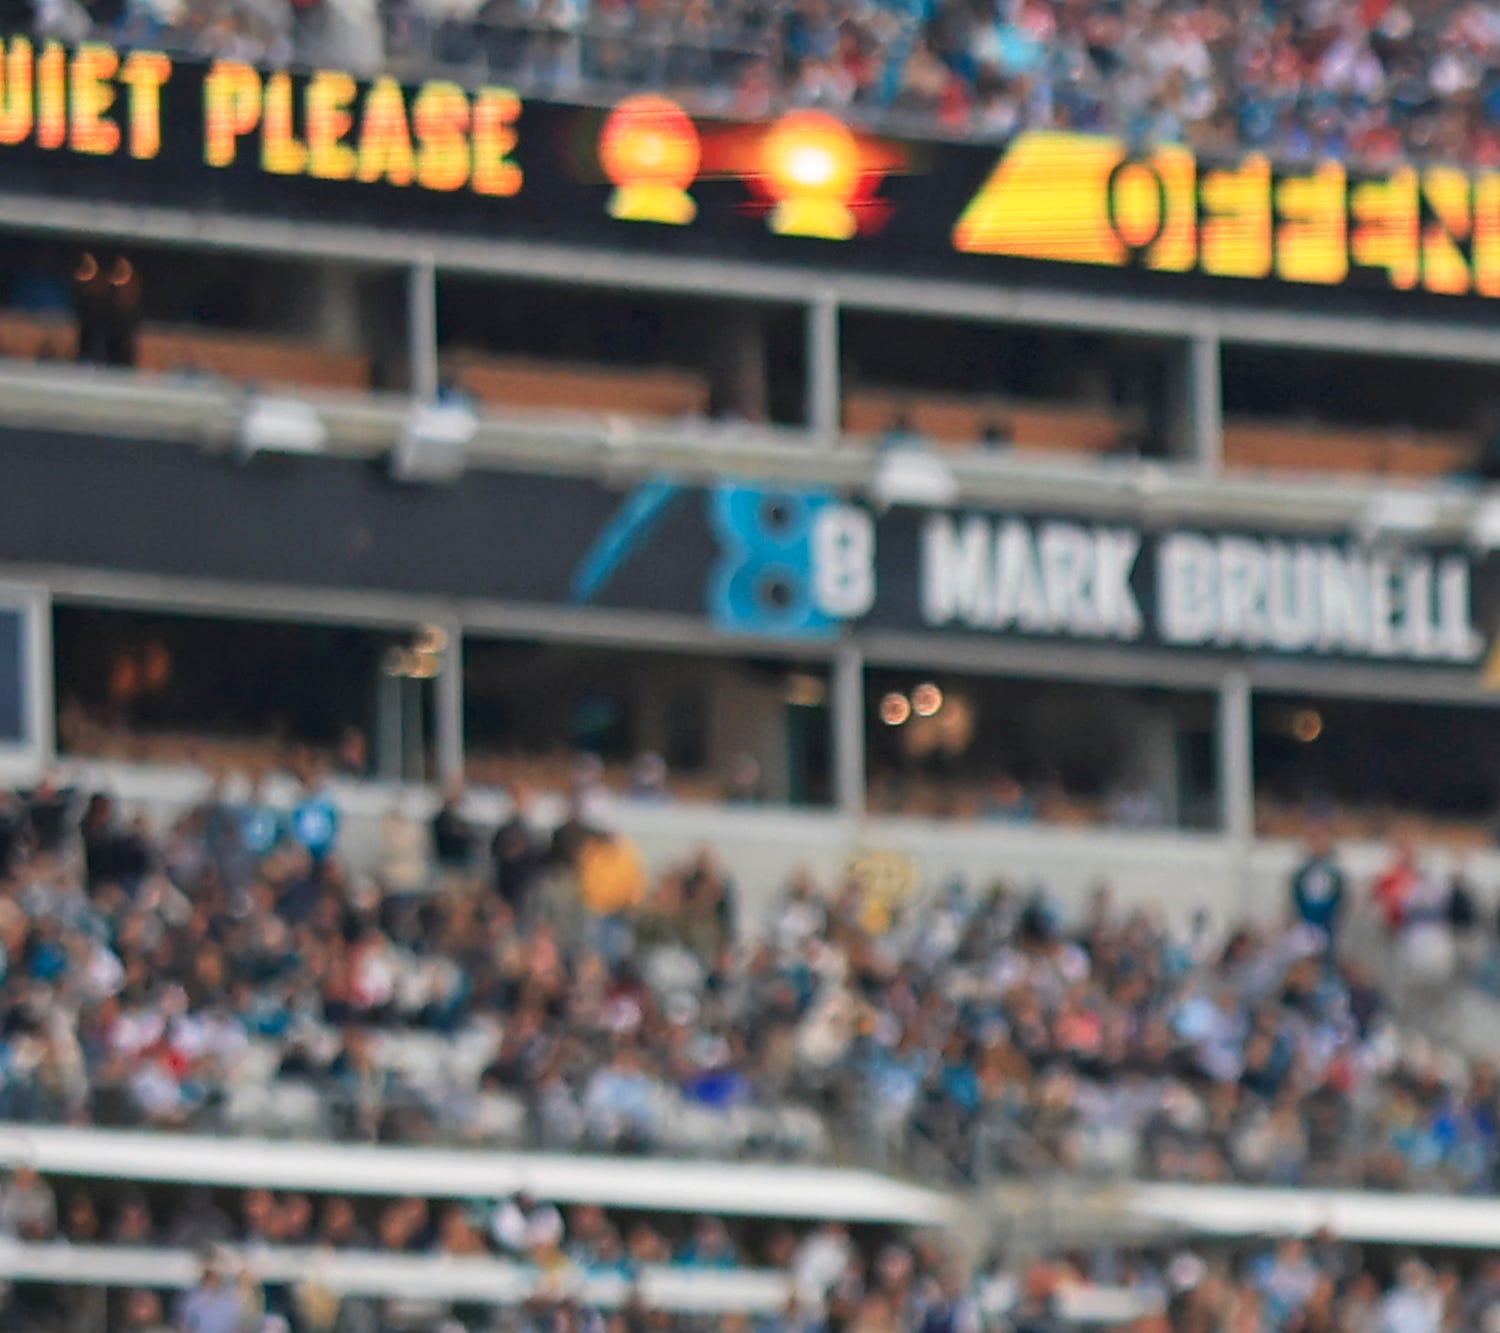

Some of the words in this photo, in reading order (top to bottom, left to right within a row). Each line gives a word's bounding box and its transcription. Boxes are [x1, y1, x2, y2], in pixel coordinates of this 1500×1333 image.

[204, 58, 524, 196] PLEASE
[921, 510, 1144, 640] MARK
[1155, 528, 1487, 662] BRUNELL
